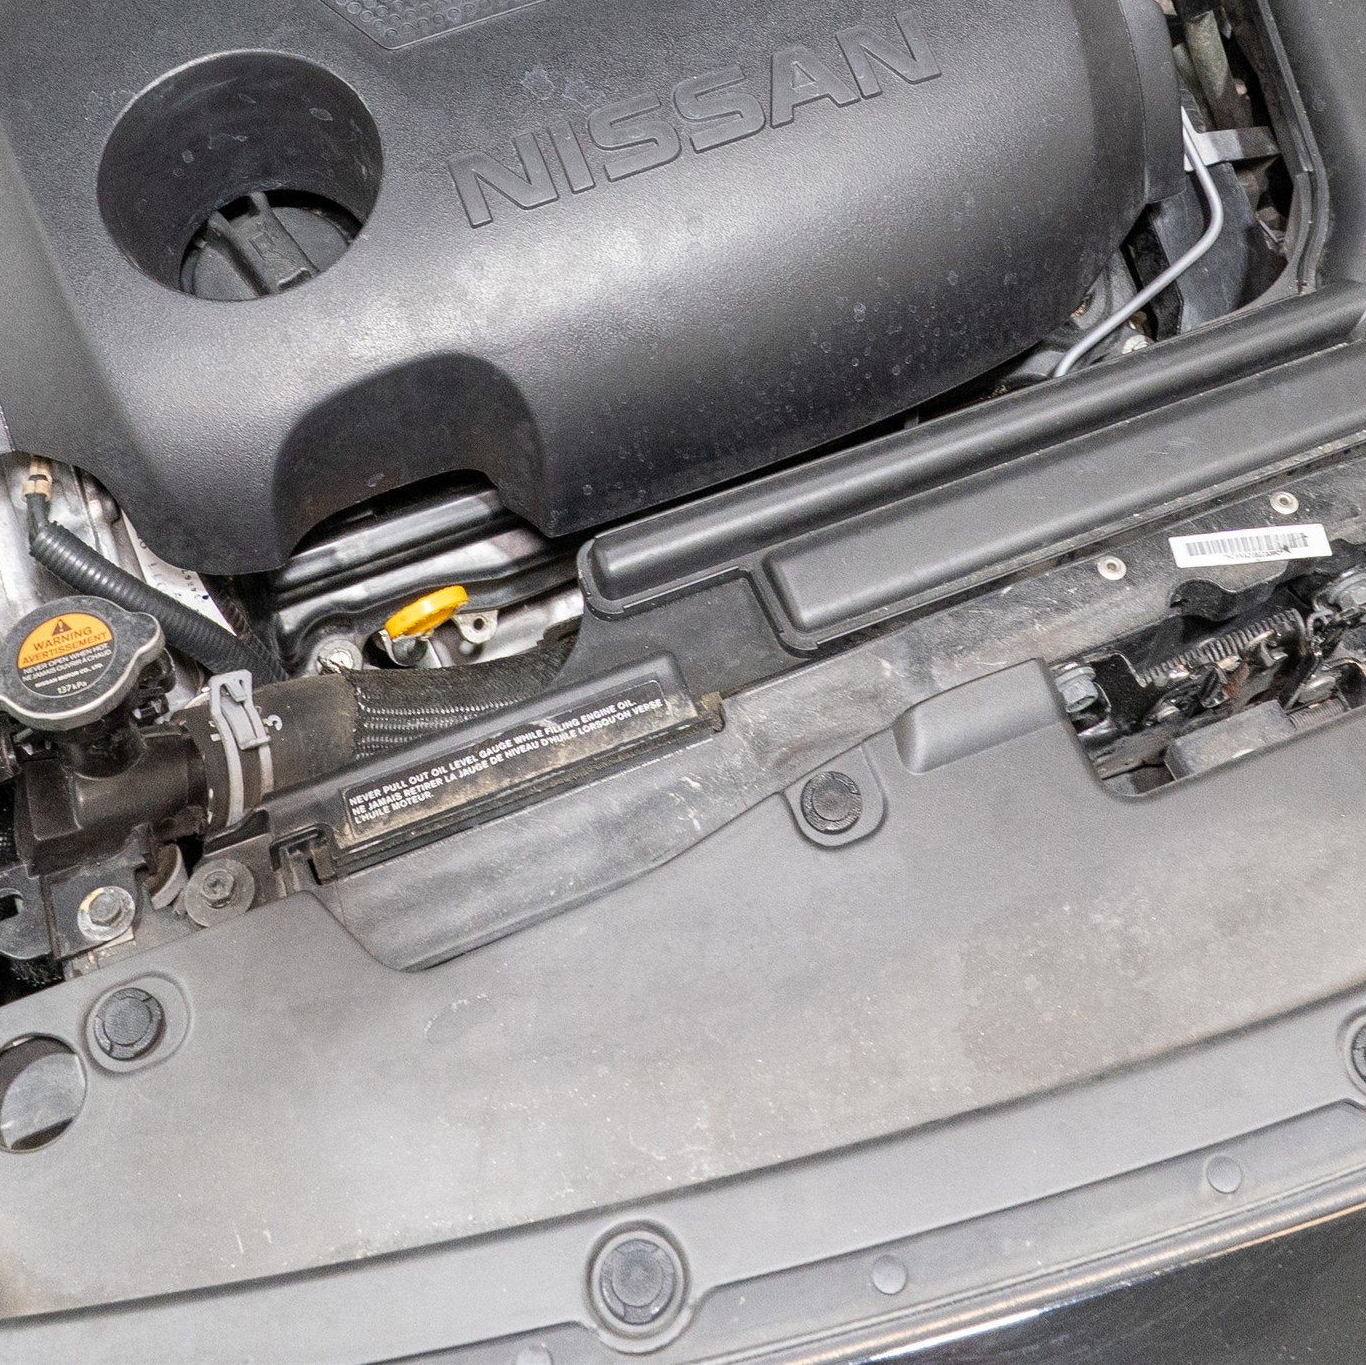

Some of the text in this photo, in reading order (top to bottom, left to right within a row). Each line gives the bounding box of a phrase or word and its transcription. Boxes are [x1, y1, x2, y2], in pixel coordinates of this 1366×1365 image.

[447, 10, 943, 230] NISSAN
[22, 631, 108, 665] AVERTISSEMENT
[33, 626, 93, 651] WARNING
[23, 662, 48, 675] NEVER
[47, 655, 70, 666] OPEN
[68, 648, 93, 661] WHEN
[349, 698, 637, 806] NEVER PULL OUT OIL LEVEL GAUGE WHILE FILLING ENGINE OIL.
[351, 804, 366, 816] NE
[368, 792, 403, 811] JAMAIS
[403, 777, 444, 798] RETIRER
[444, 773, 457, 784] LA
[458, 760, 490, 779] JAUGE
[489, 753, 505, 766] DE
[505, 741, 540, 760] NIVEAU
[540, 728, 578, 748] D'HUILE
[578, 709, 632, 735] LORSQU'ON
[353, 791, 435, 825] L'HUILE MOTEUR.
